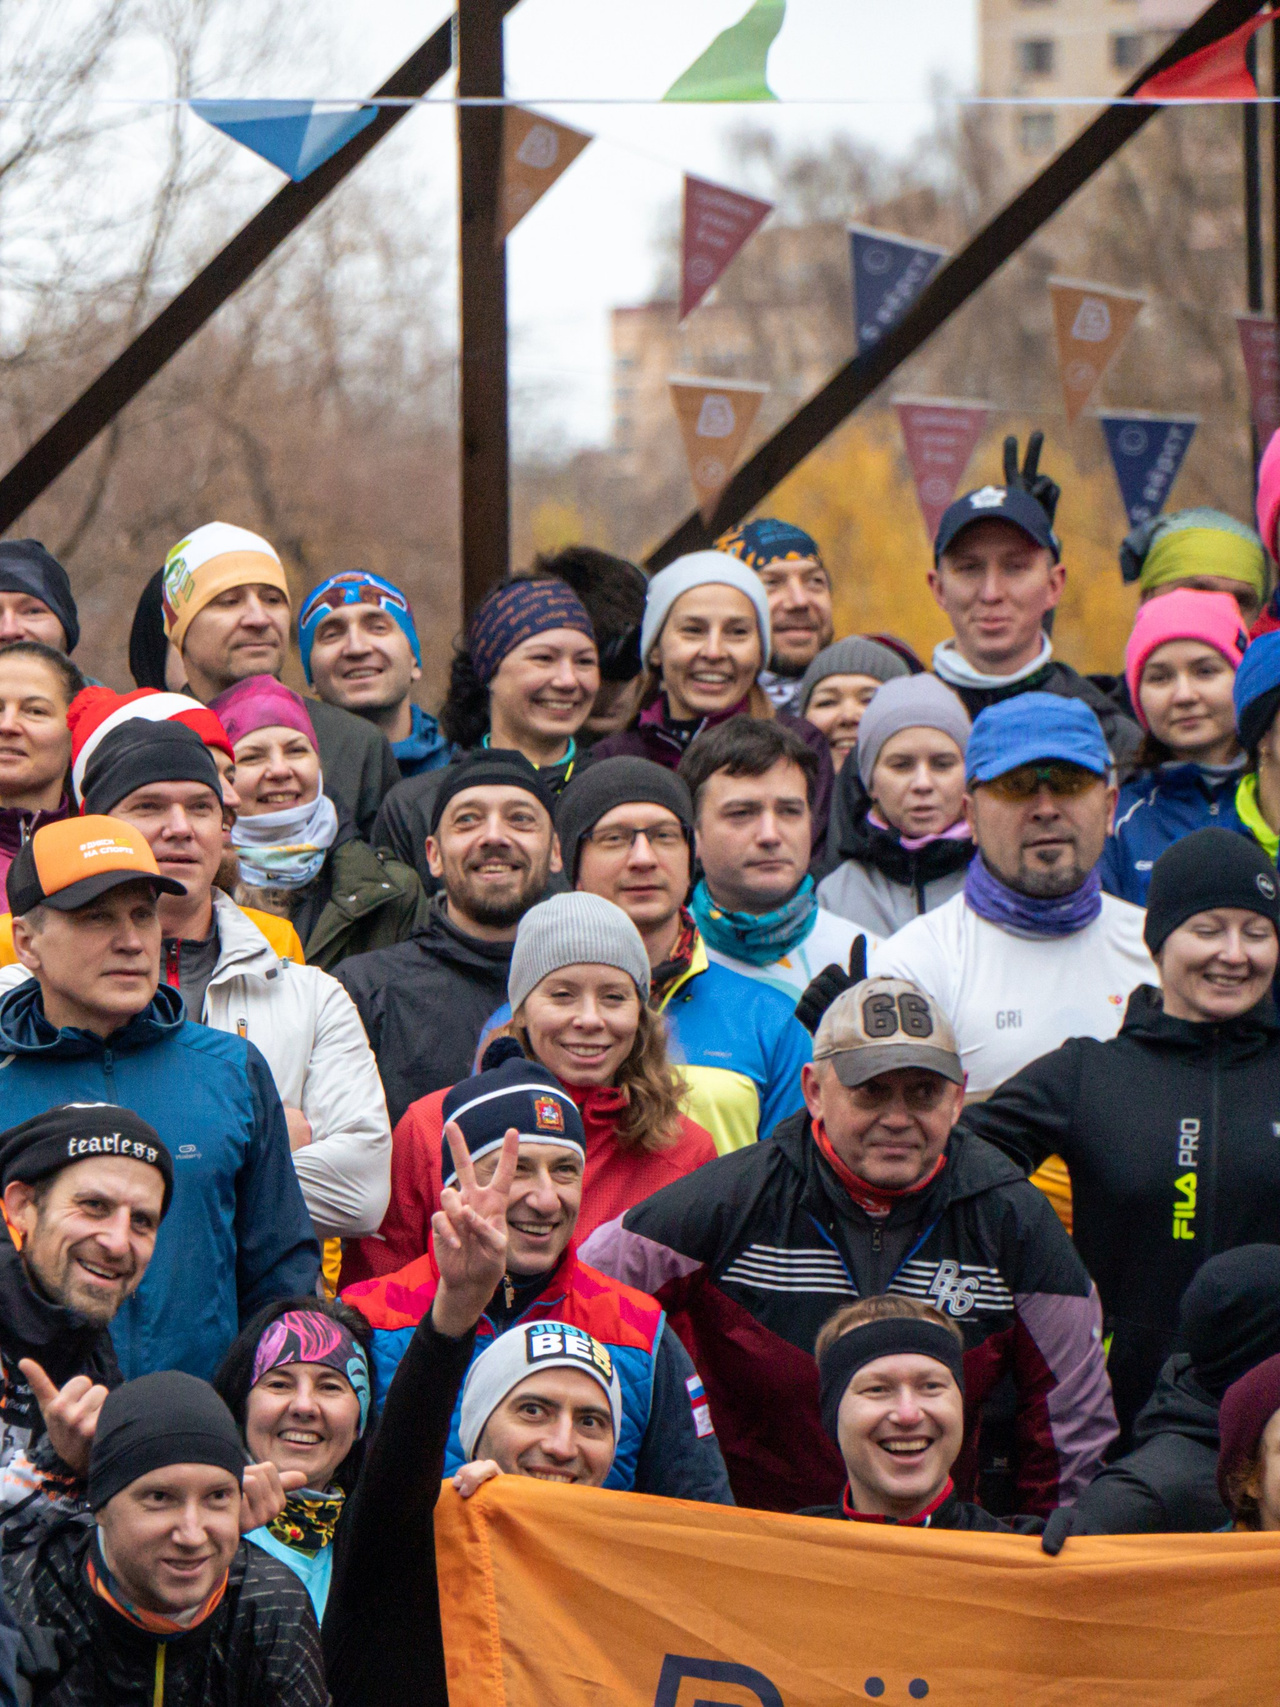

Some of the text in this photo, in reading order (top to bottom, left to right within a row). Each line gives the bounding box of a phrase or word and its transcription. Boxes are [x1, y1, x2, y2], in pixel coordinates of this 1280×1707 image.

[862, 993, 933, 1038] 66
[67, 1132, 159, 1163] fearless
[1173, 1118, 1200, 1240] FILA PRO
[530, 1324, 589, 1342] JUST
[531, 1333, 593, 1361] BE
